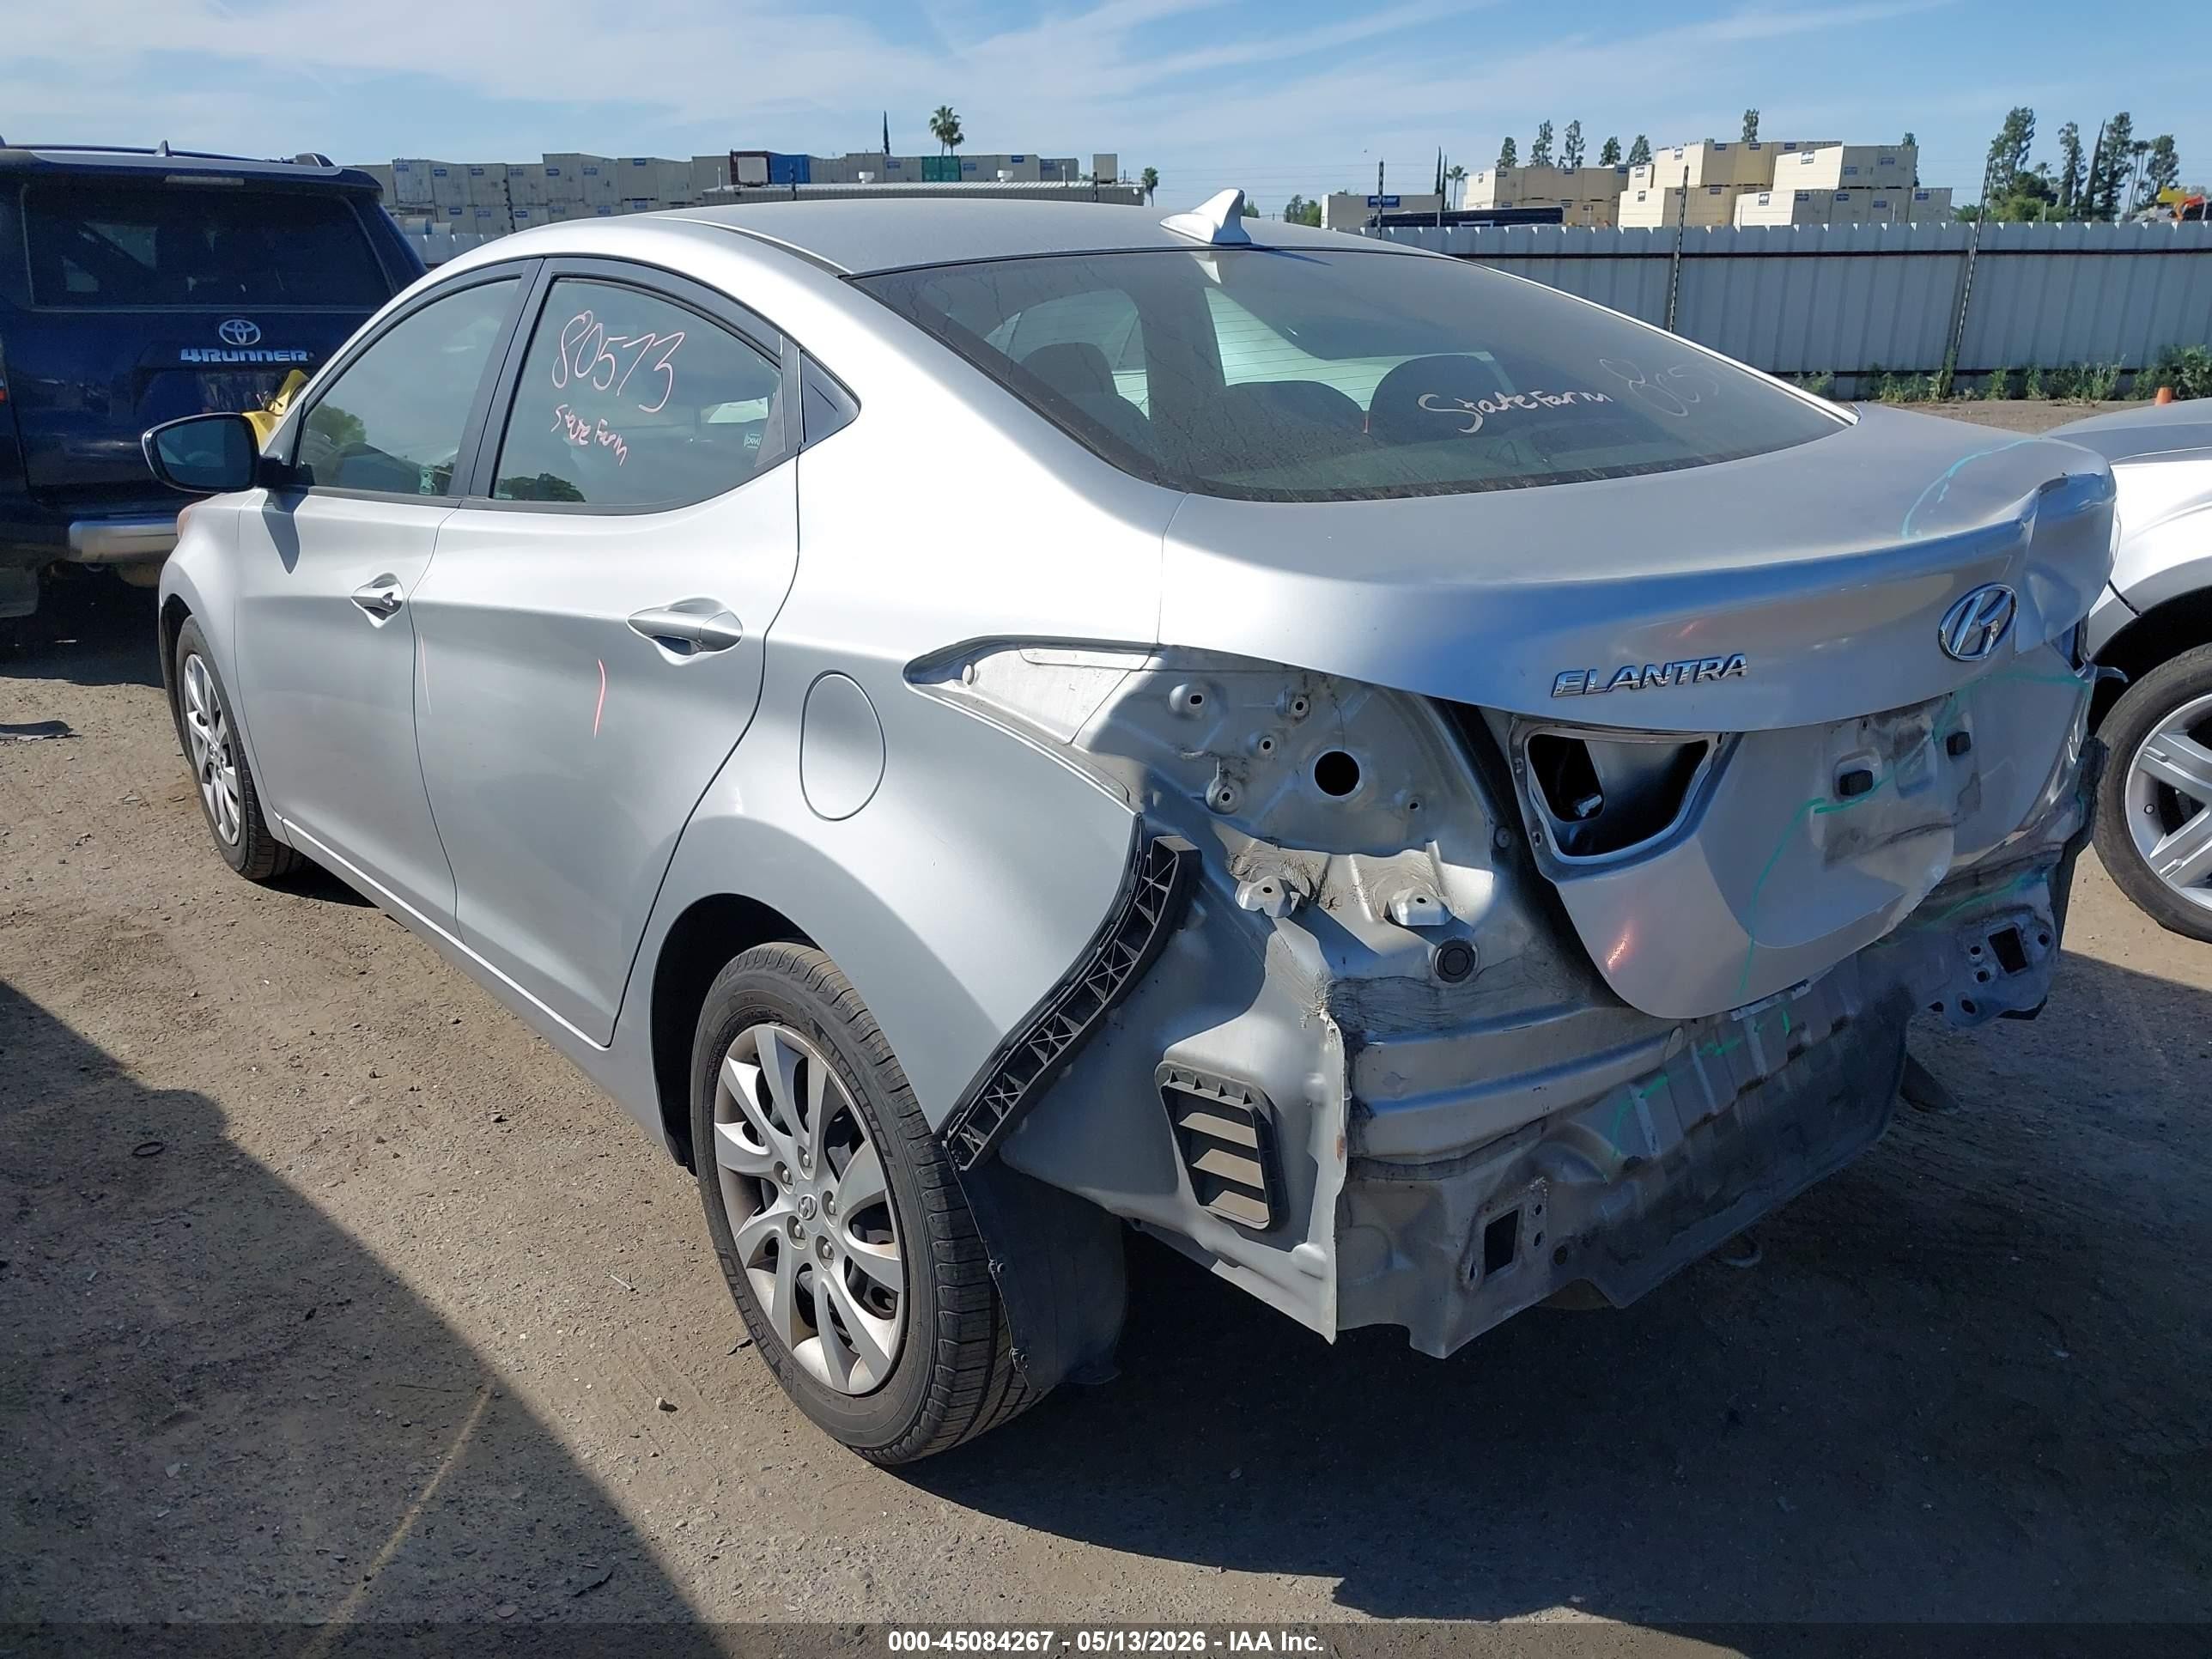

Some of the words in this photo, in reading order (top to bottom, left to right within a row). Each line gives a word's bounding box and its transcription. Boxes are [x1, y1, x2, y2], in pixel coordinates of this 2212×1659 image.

[179, 348, 309, 363] 4RUNNER
[551, 310, 685, 413] 80573
[1551, 653, 1748, 698] ELANTRA
